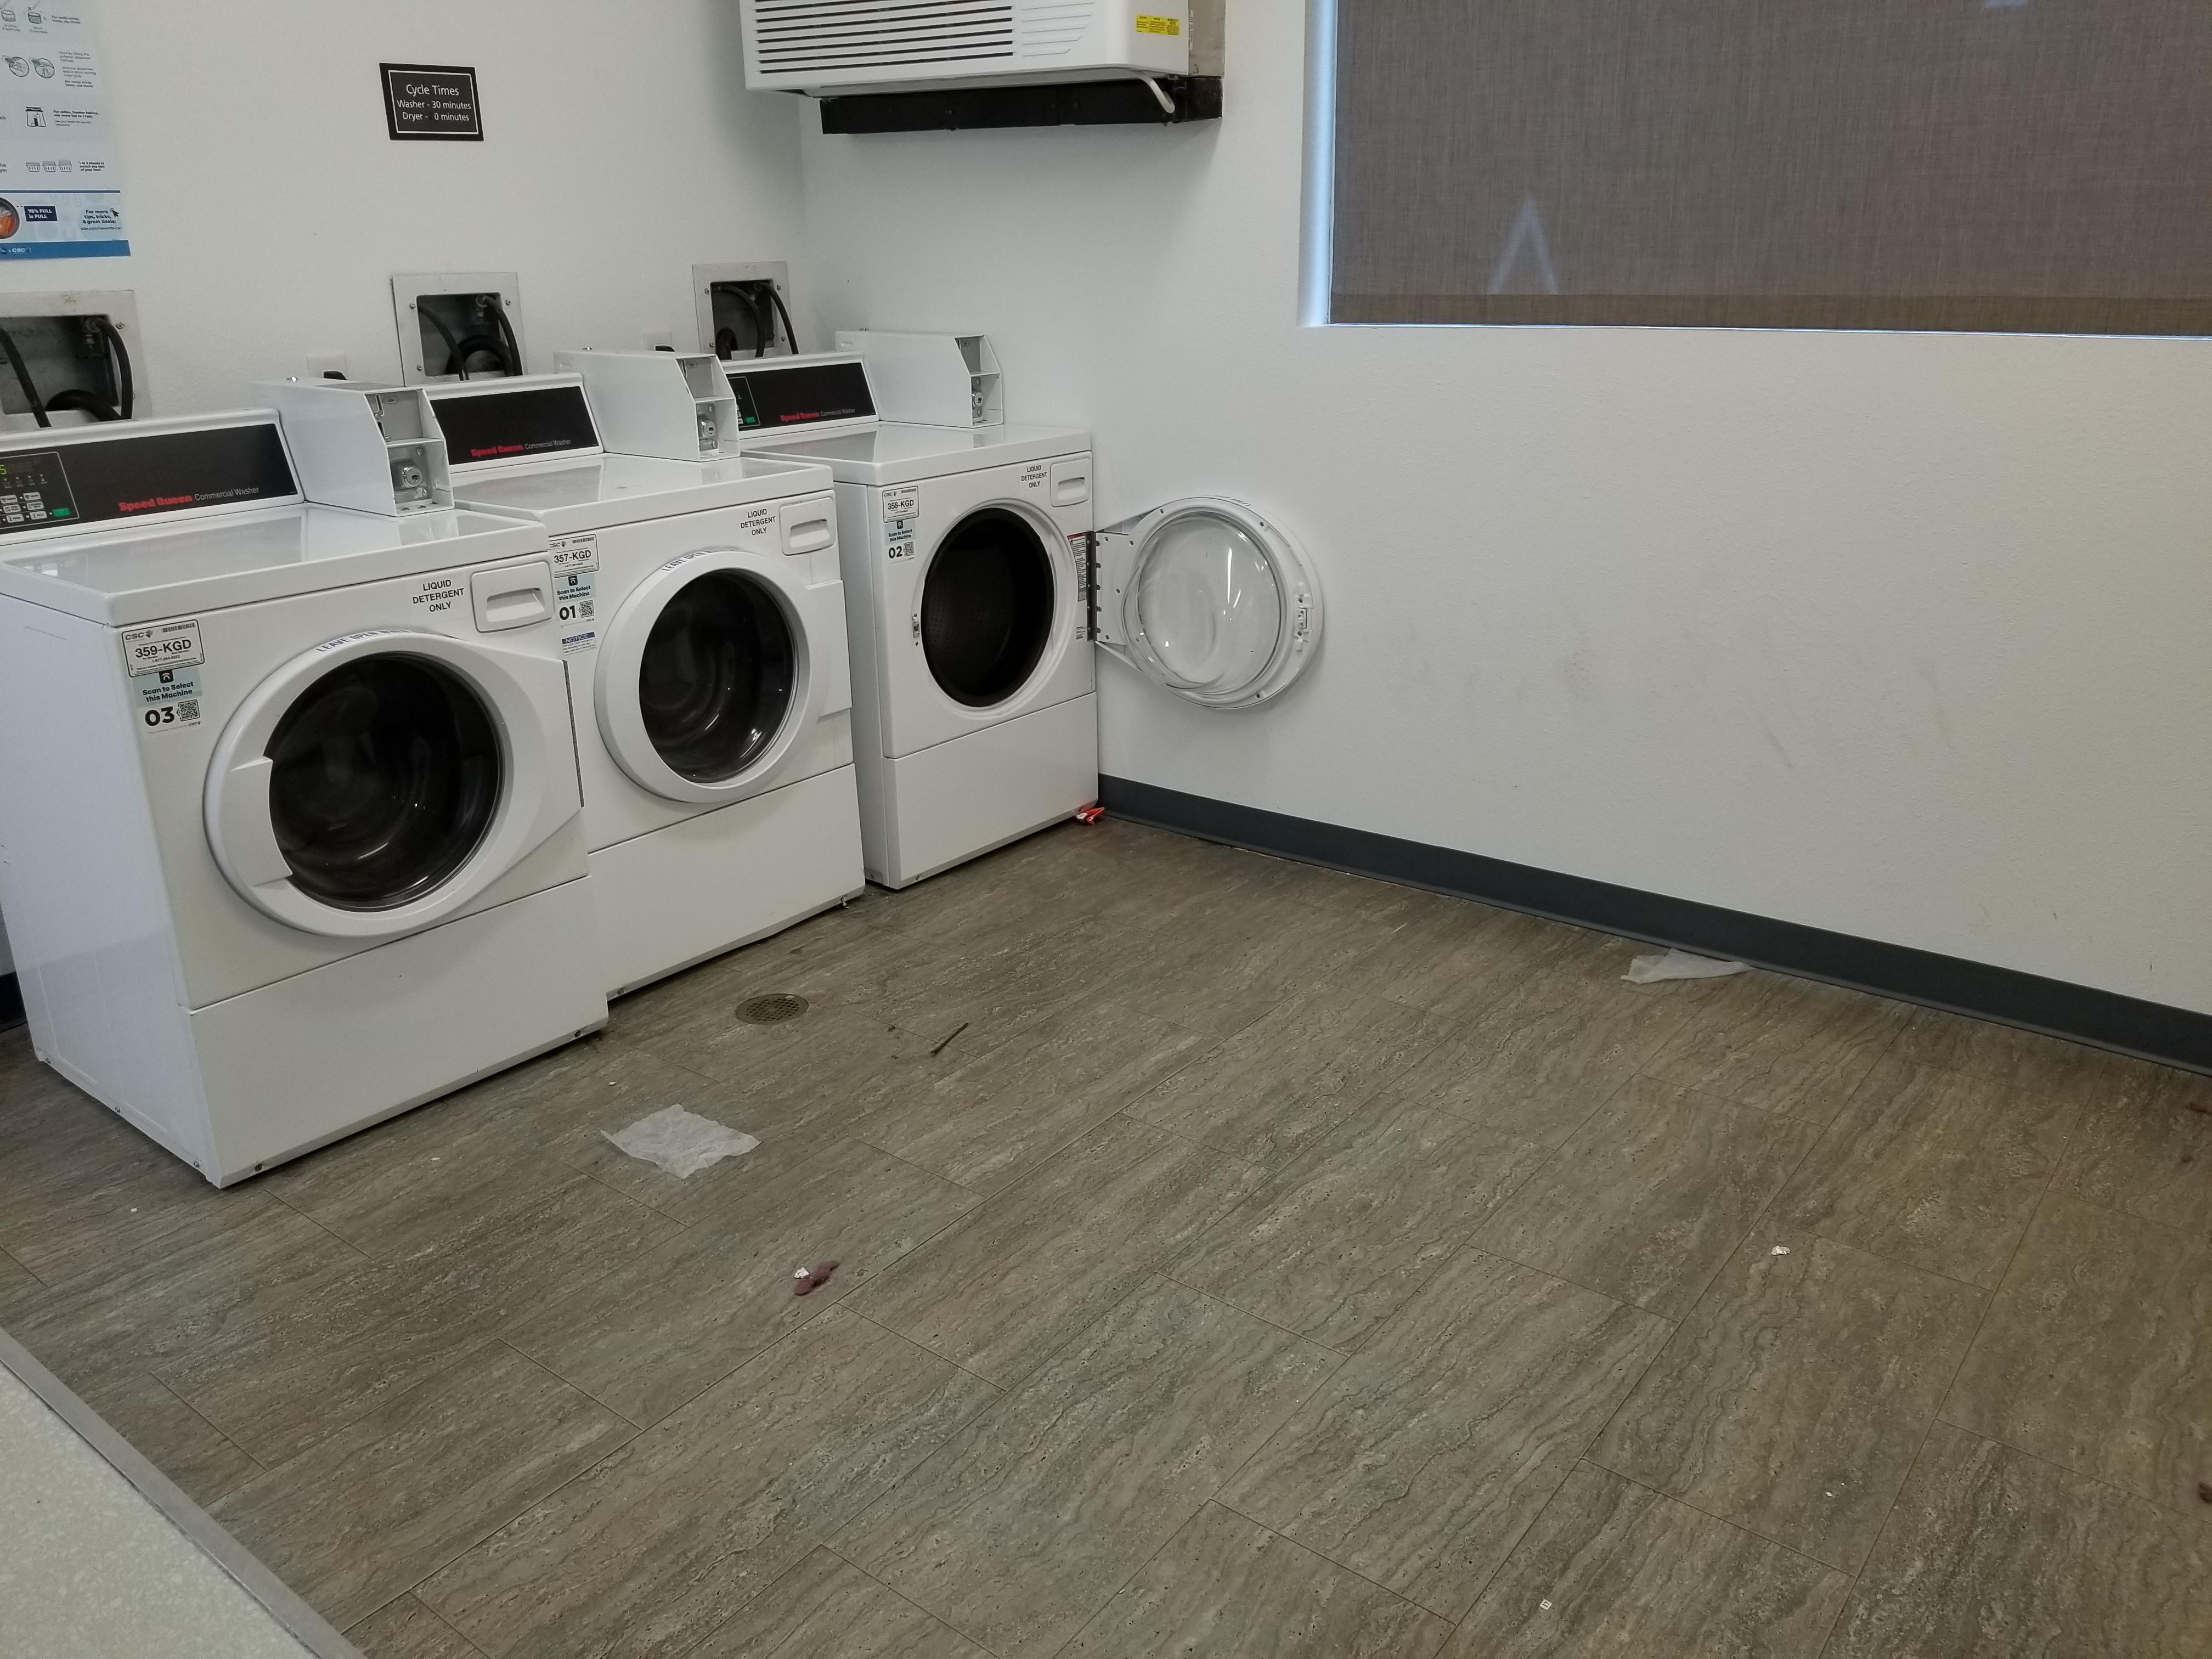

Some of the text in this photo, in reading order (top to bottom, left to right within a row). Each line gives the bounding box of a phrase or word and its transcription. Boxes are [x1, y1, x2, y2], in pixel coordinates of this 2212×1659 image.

[406, 84, 459, 97] Cycle Times
[397, 99, 425, 108] Washer
[432, 100, 441, 109] 30
[443, 101, 471, 110] minutes
[402, 111, 423, 122] Dryer
[441, 113, 470, 121] minutes
[470, 446, 498, 457] Speed
[498, 444, 524, 453] Queen
[524, 441, 552, 450] Commercial
[1021, 472, 1047, 482] DETERGENT
[119, 487, 259, 512] Speed Queen Commercial Washer
[887, 499, 914, 510] 358-KGD
[747, 509, 768, 518] LIQUID
[741, 516, 776, 529] DETERGENT
[751, 527, 767, 535] ONLY
[554, 550, 591, 563] 357-KGD
[888, 545, 903, 559] 02
[661, 559, 687, 571] LEAVE
[422, 579, 452, 591] LIQUID
[413, 588, 465, 605] DETERGENT
[429, 601, 452, 612] ONLY
[559, 605, 576, 620] 01
[125, 632, 144, 640] CSC
[315, 631, 380, 652] LEAVE OPEN
[566, 634, 589, 644] NOTICE
[135, 639, 191, 658] 359-KGD
[171, 681, 194, 691] Select
[146, 689, 193, 702] this Machine
[145, 706, 175, 726] 03
